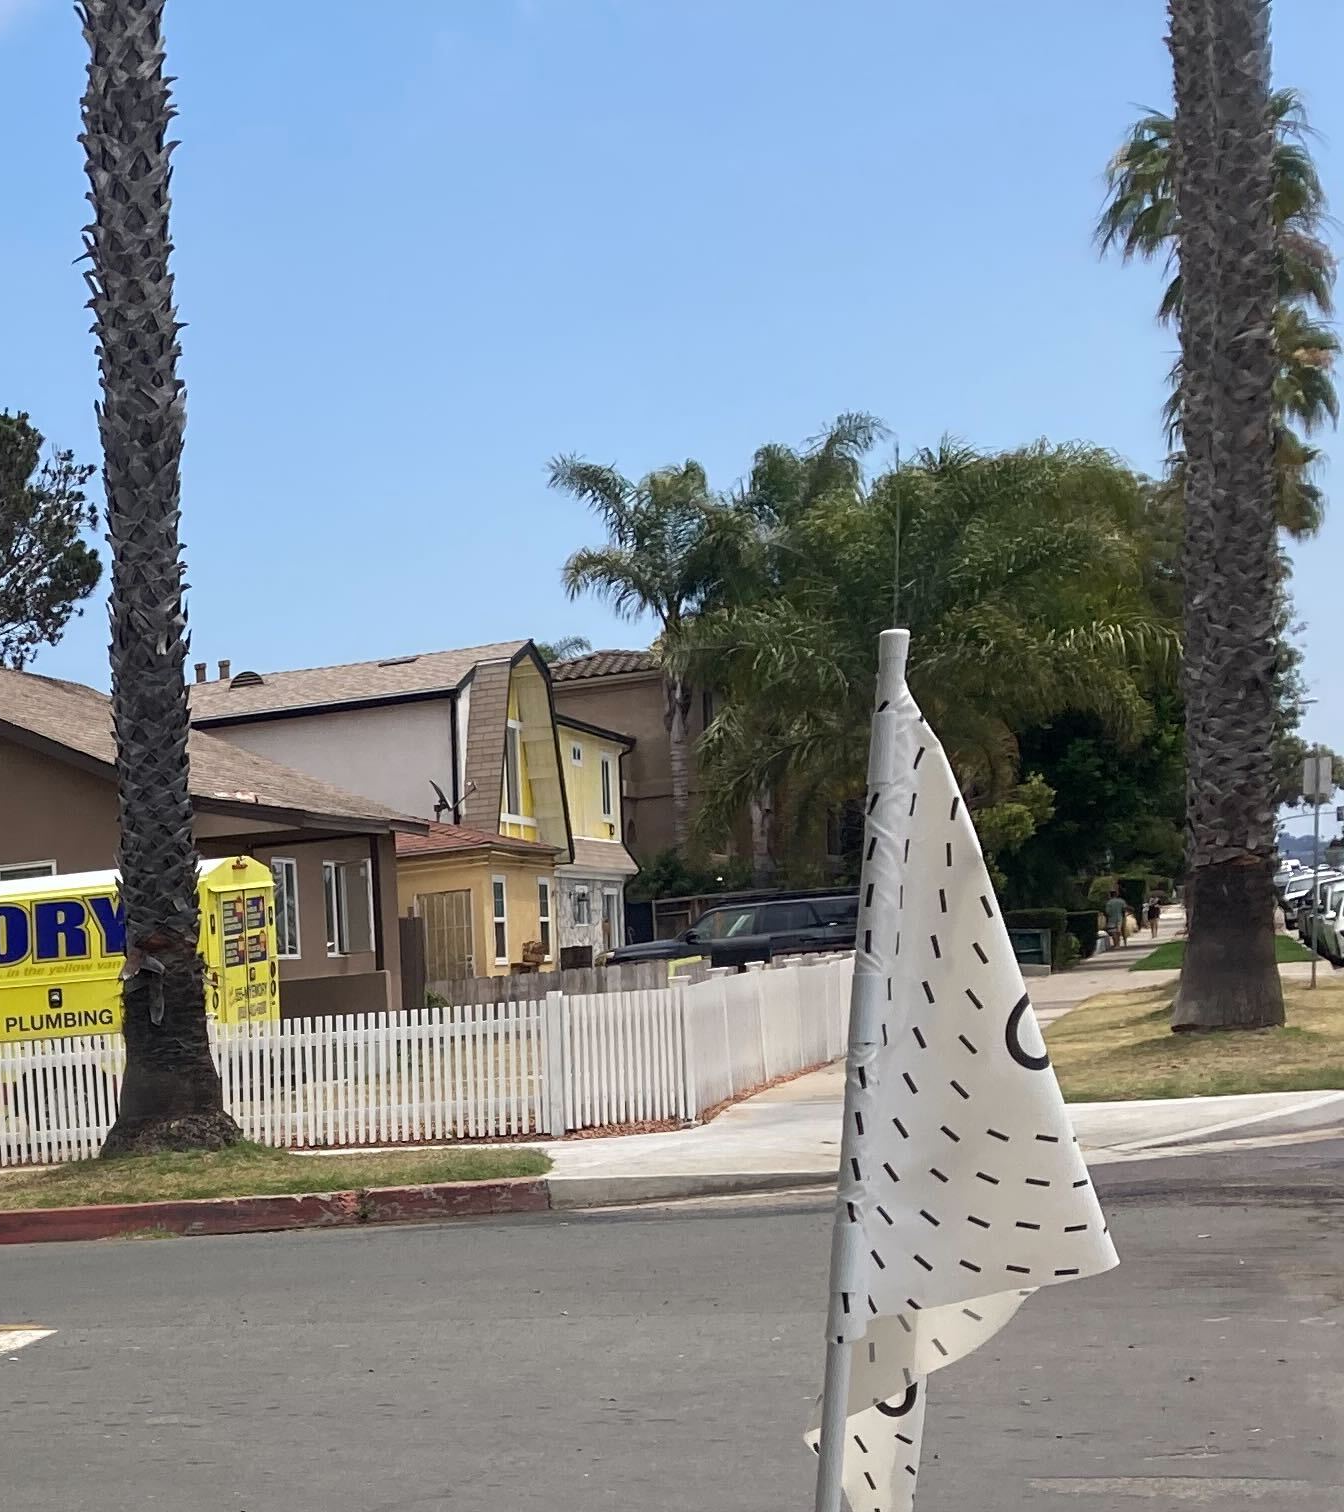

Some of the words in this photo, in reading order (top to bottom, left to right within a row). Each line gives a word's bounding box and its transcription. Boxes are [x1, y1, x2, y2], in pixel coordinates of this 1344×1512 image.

[6, 968, 19, 978] in
[23, 966, 45, 976] the
[49, 962, 93, 976] yellow
[5, 1008, 113, 1032] PLUMBING
